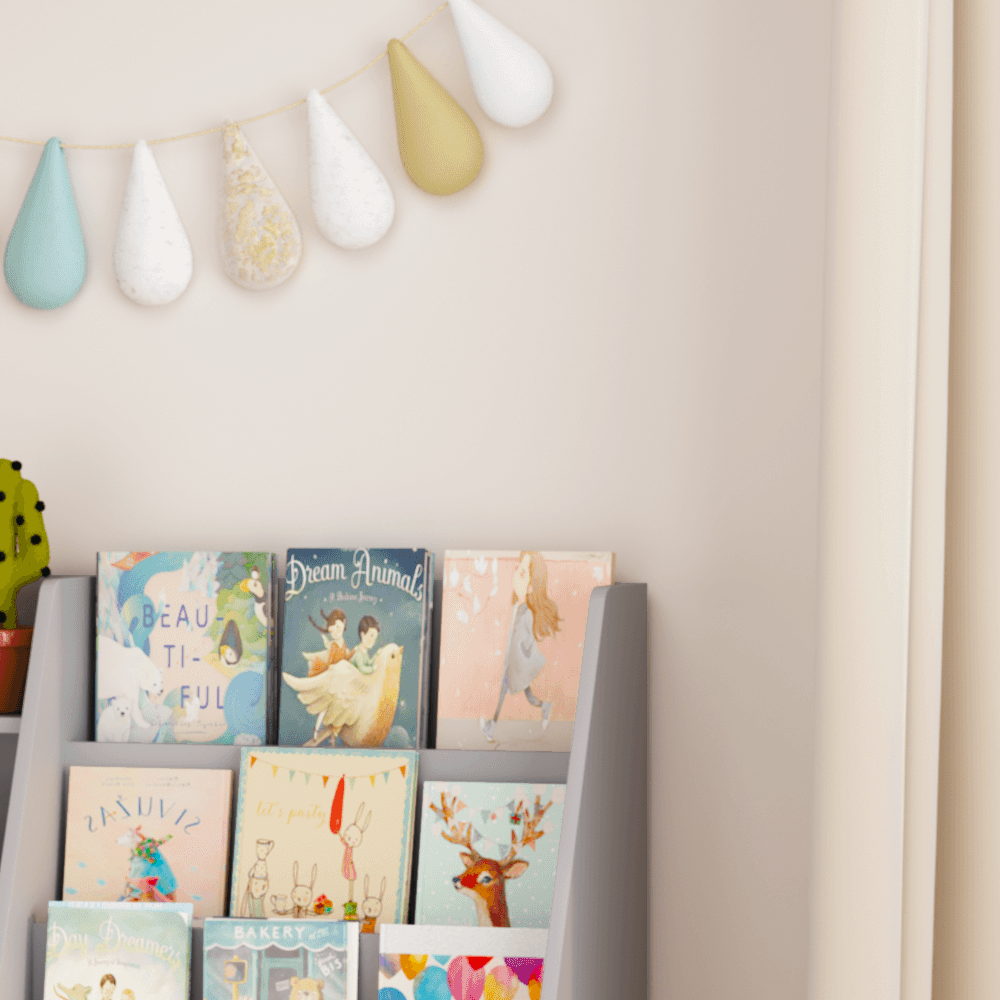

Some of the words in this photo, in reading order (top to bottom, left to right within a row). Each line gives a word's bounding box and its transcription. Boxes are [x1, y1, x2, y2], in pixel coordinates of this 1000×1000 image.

[285, 554, 347, 601] Dream
[350, 547, 424, 601] Animals
[142, 603, 224, 628] BEAU-
[163, 644, 200, 668] TI-
[180, 685, 224, 710] FUL
[233, 925, 305, 940] BAKERY
